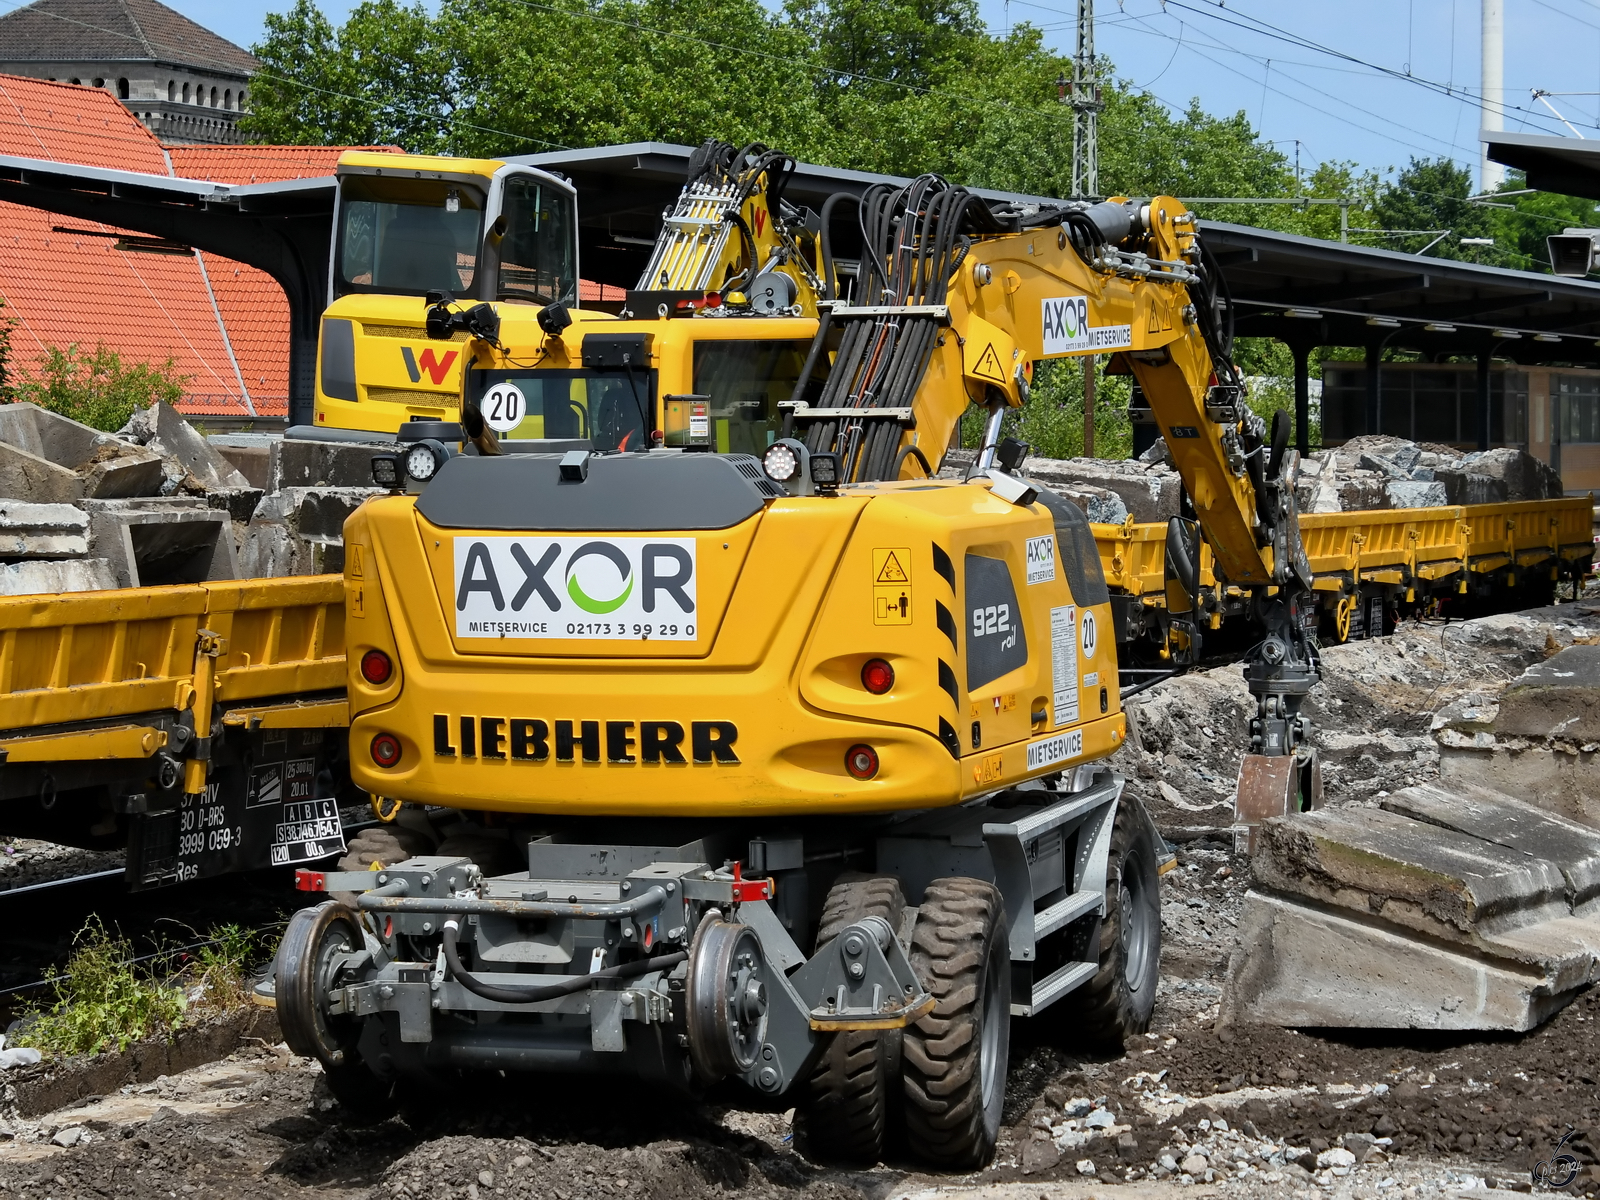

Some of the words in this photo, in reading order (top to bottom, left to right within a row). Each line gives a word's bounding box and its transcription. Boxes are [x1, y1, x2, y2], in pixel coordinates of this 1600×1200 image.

[1043, 299, 1087, 340] AXOR
[1088, 328, 1130, 346] MIETSERVICE
[491, 391, 518, 421] 20
[1028, 538, 1053, 563] AXOR
[456, 541, 695, 614] AXOR
[1028, 569, 1054, 581] MIETSERVICE
[469, 621, 548, 633] MIETSERVICE
[566, 623, 611, 635] 02173
[618, 623, 626, 635] 3
[633, 623, 652, 635] 99
[659, 624, 678, 636] 29
[686, 624, 695, 636] 0
[973, 603, 1010, 637] 922
[1001, 624, 1017, 652] rail
[1083, 617, 1094, 649] 20
[433, 713, 742, 763] LIEBHERR
[1027, 733, 1082, 767] MIETSERVICE
[201, 783, 220, 804] RIV
[199, 805, 225, 830] D-BRS
[289, 806, 296, 821] A
[304, 804, 312, 819] B
[322, 802, 331, 817] C
[209, 826, 242, 850] 059-3
[278, 826, 285, 842] S
[273, 846, 287, 862] 120
[177, 861, 199, 882] Res
